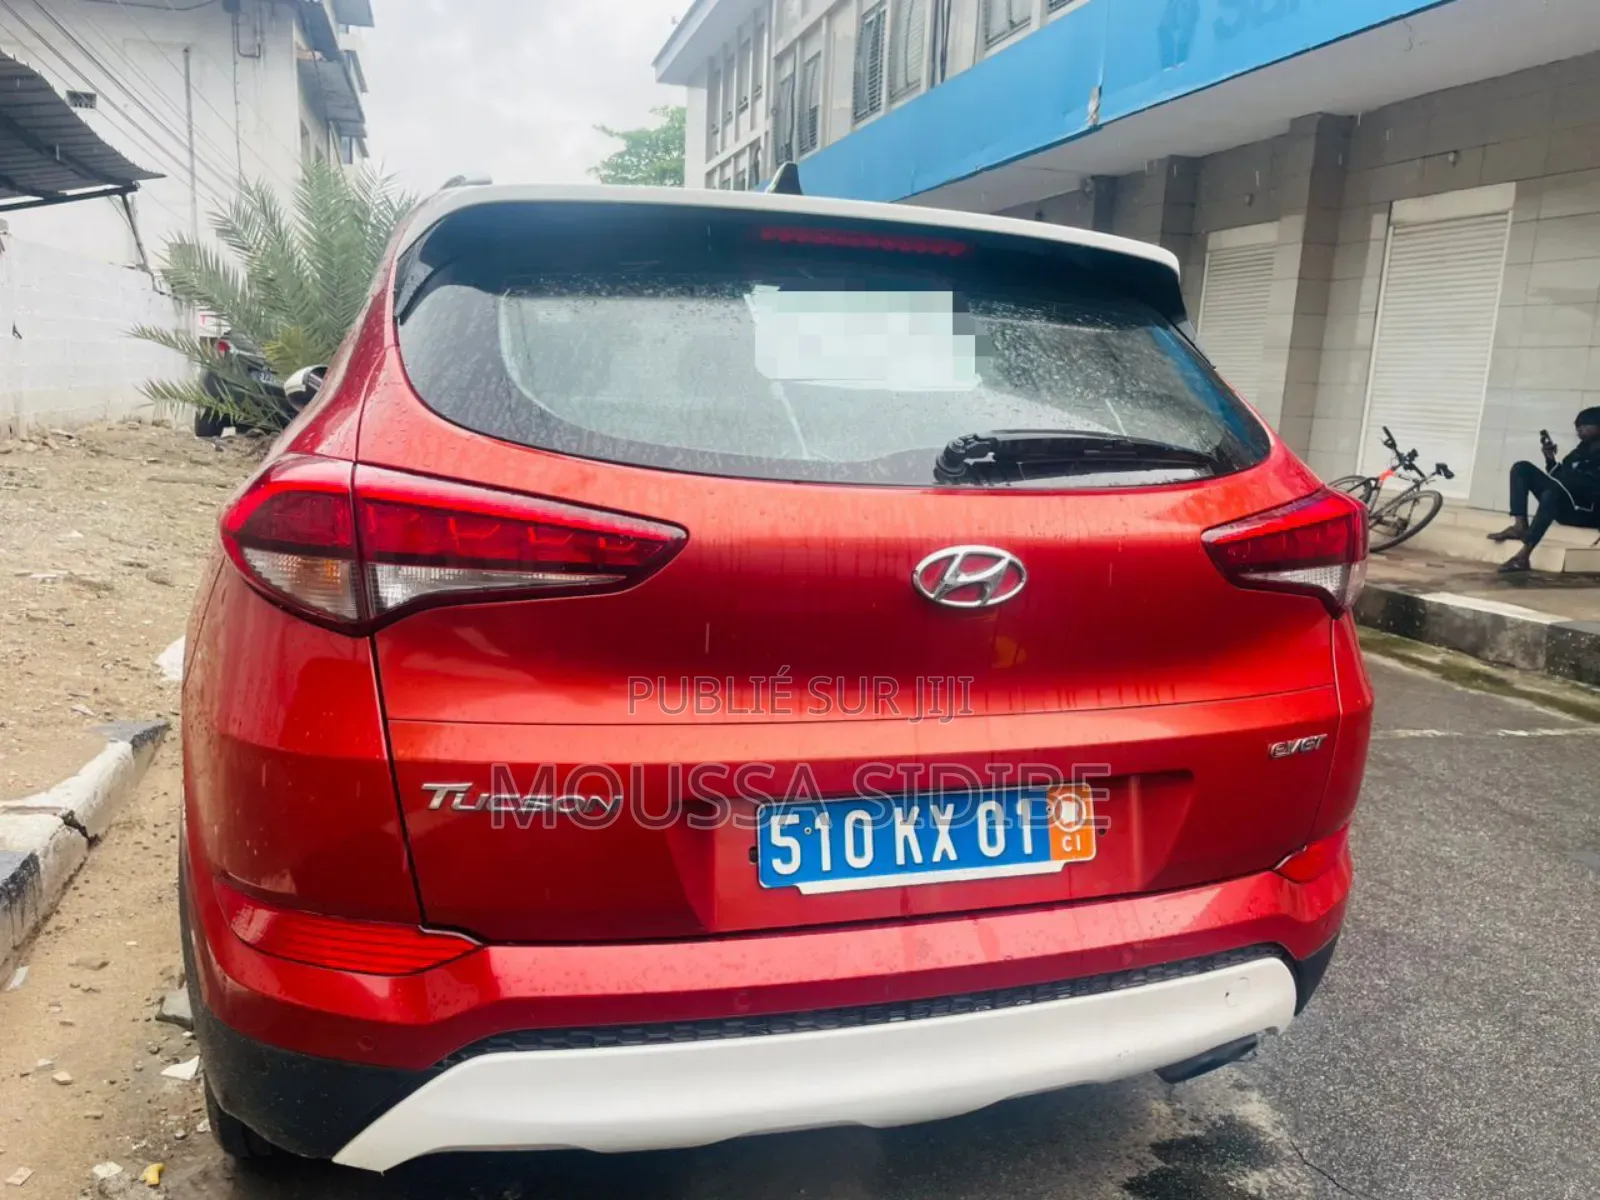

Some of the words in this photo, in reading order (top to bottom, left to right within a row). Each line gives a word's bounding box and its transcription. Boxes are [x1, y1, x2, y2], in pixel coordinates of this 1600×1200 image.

[770, 808, 875, 876] 510
[894, 802, 959, 865] KX
[977, 798, 1033, 857] 01
[1062, 834, 1081, 852] CI
